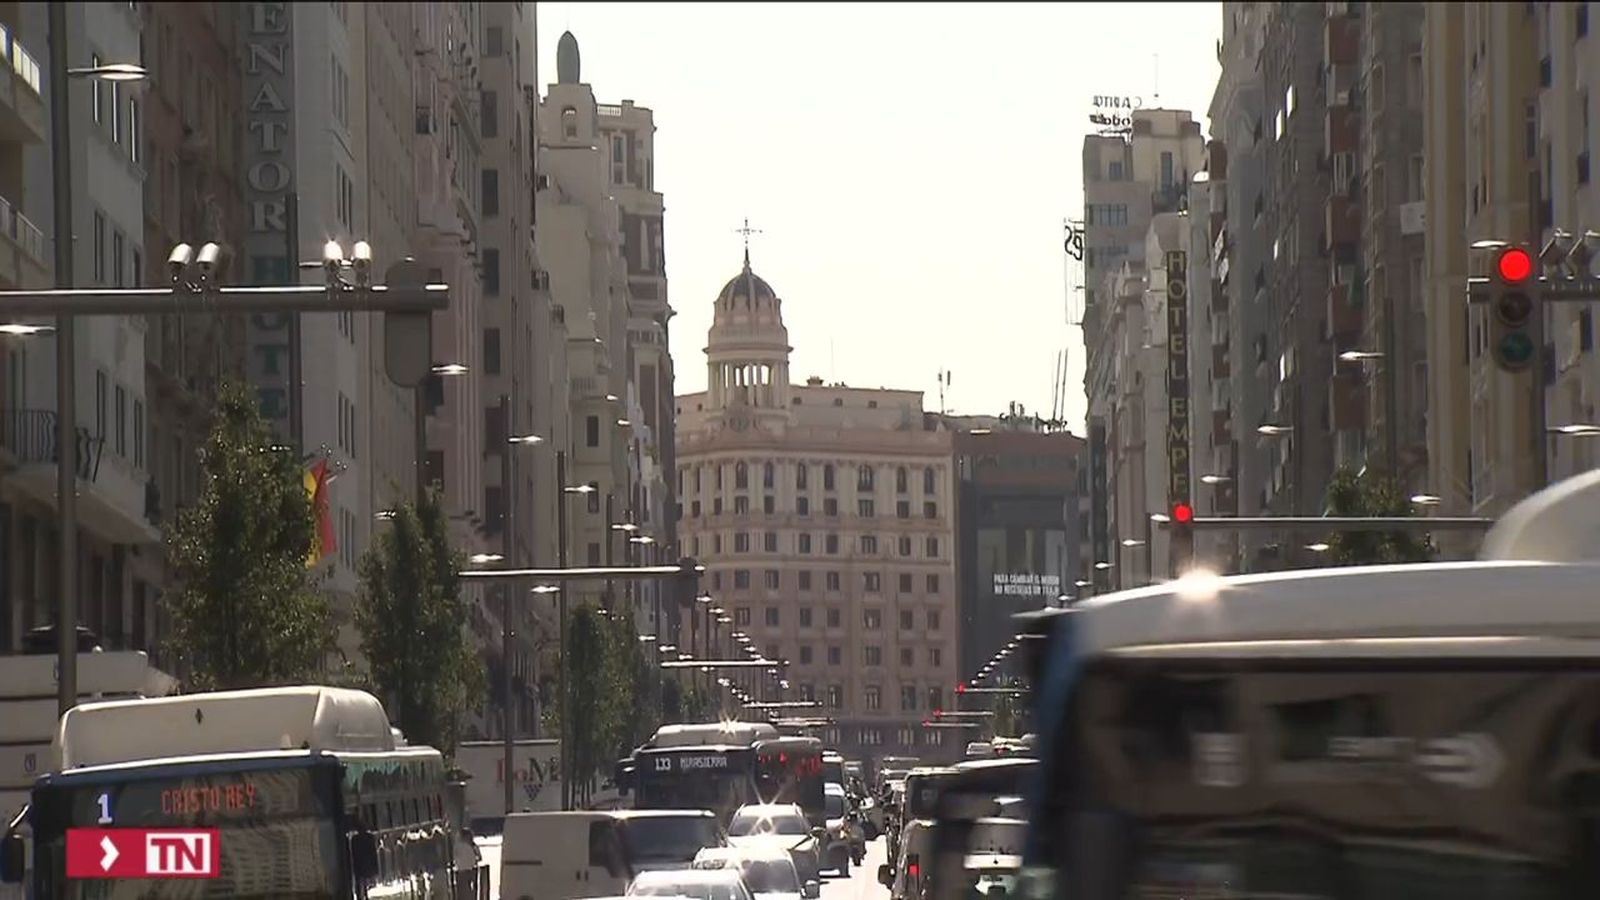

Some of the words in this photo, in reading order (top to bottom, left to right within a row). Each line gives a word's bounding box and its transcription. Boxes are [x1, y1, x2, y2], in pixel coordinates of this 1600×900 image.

[1167, 254, 1186, 380] HOTEL
[1169, 397, 1189, 499] EMPE
[655, 757, 671, 771] 133
[97, 793, 114, 824] 1
[161, 785, 220, 815] CRISTO
[225, 783, 257, 809] REY
